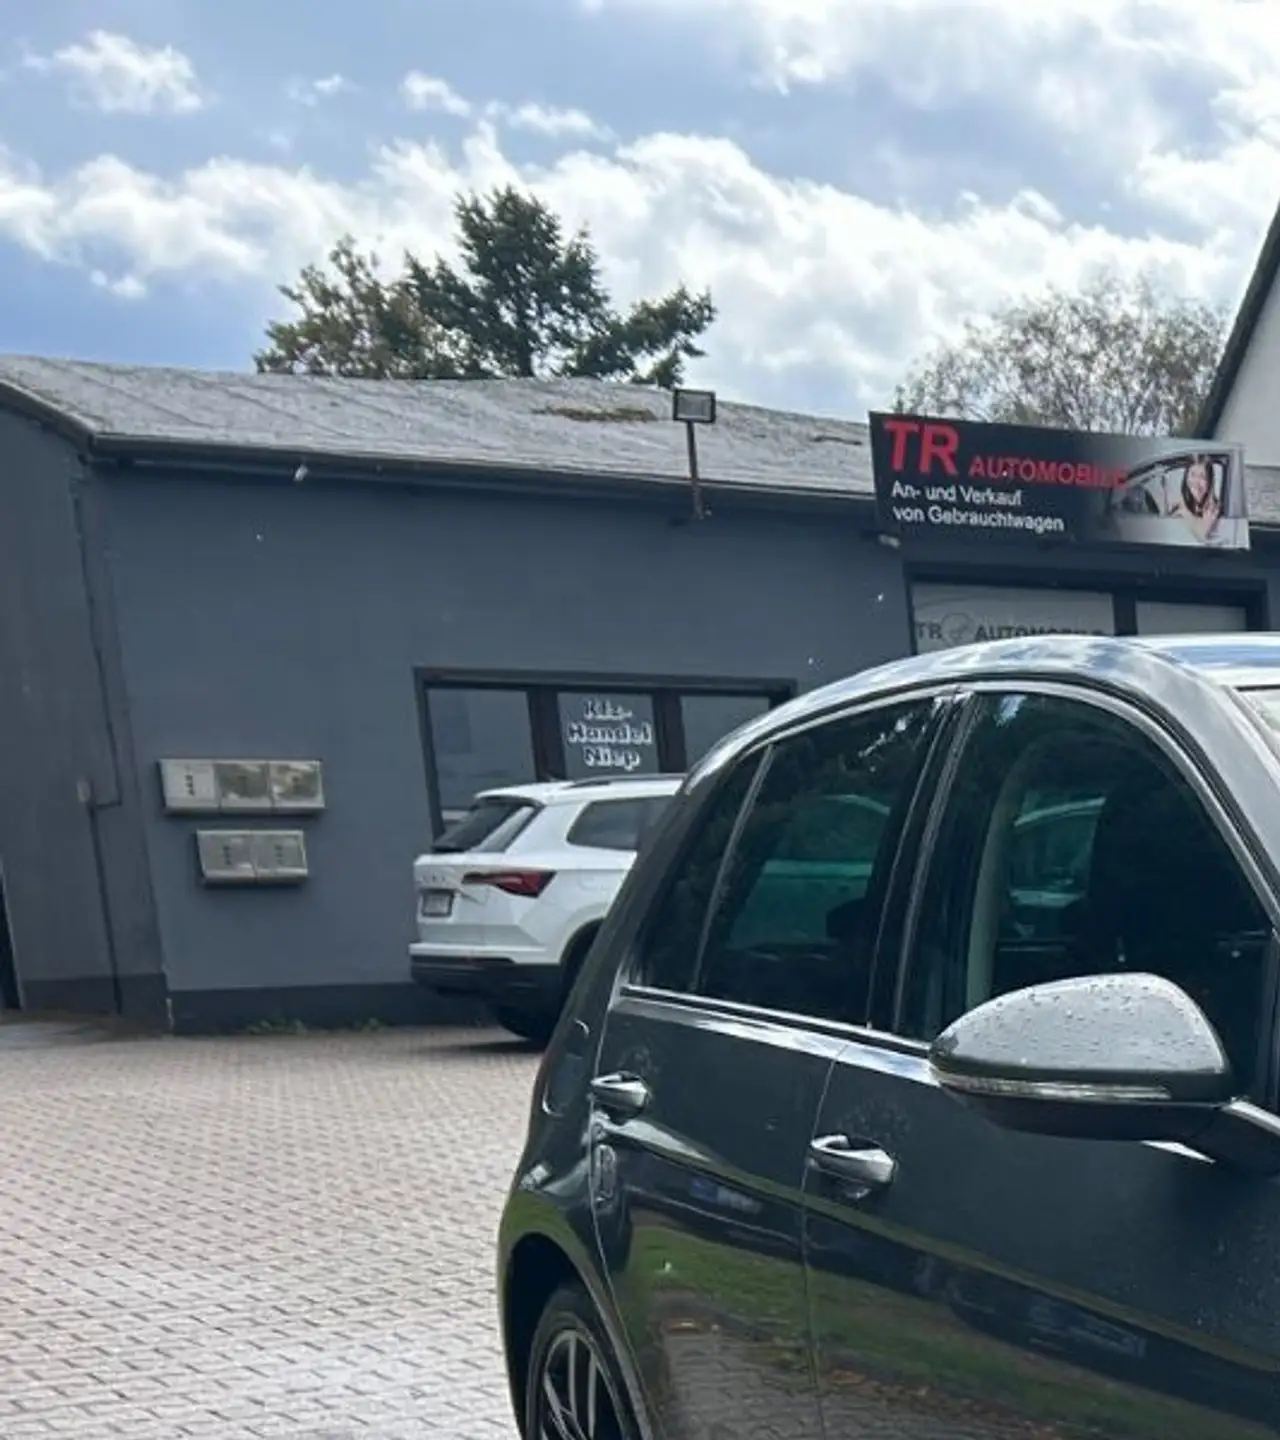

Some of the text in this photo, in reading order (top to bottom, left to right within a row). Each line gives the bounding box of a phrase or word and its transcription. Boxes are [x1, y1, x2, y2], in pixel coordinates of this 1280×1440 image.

[884, 420, 959, 476] TR
[891, 480, 1022, 507] An- und Verkauf
[893, 506, 1065, 534] von Gebrauchtwagen
